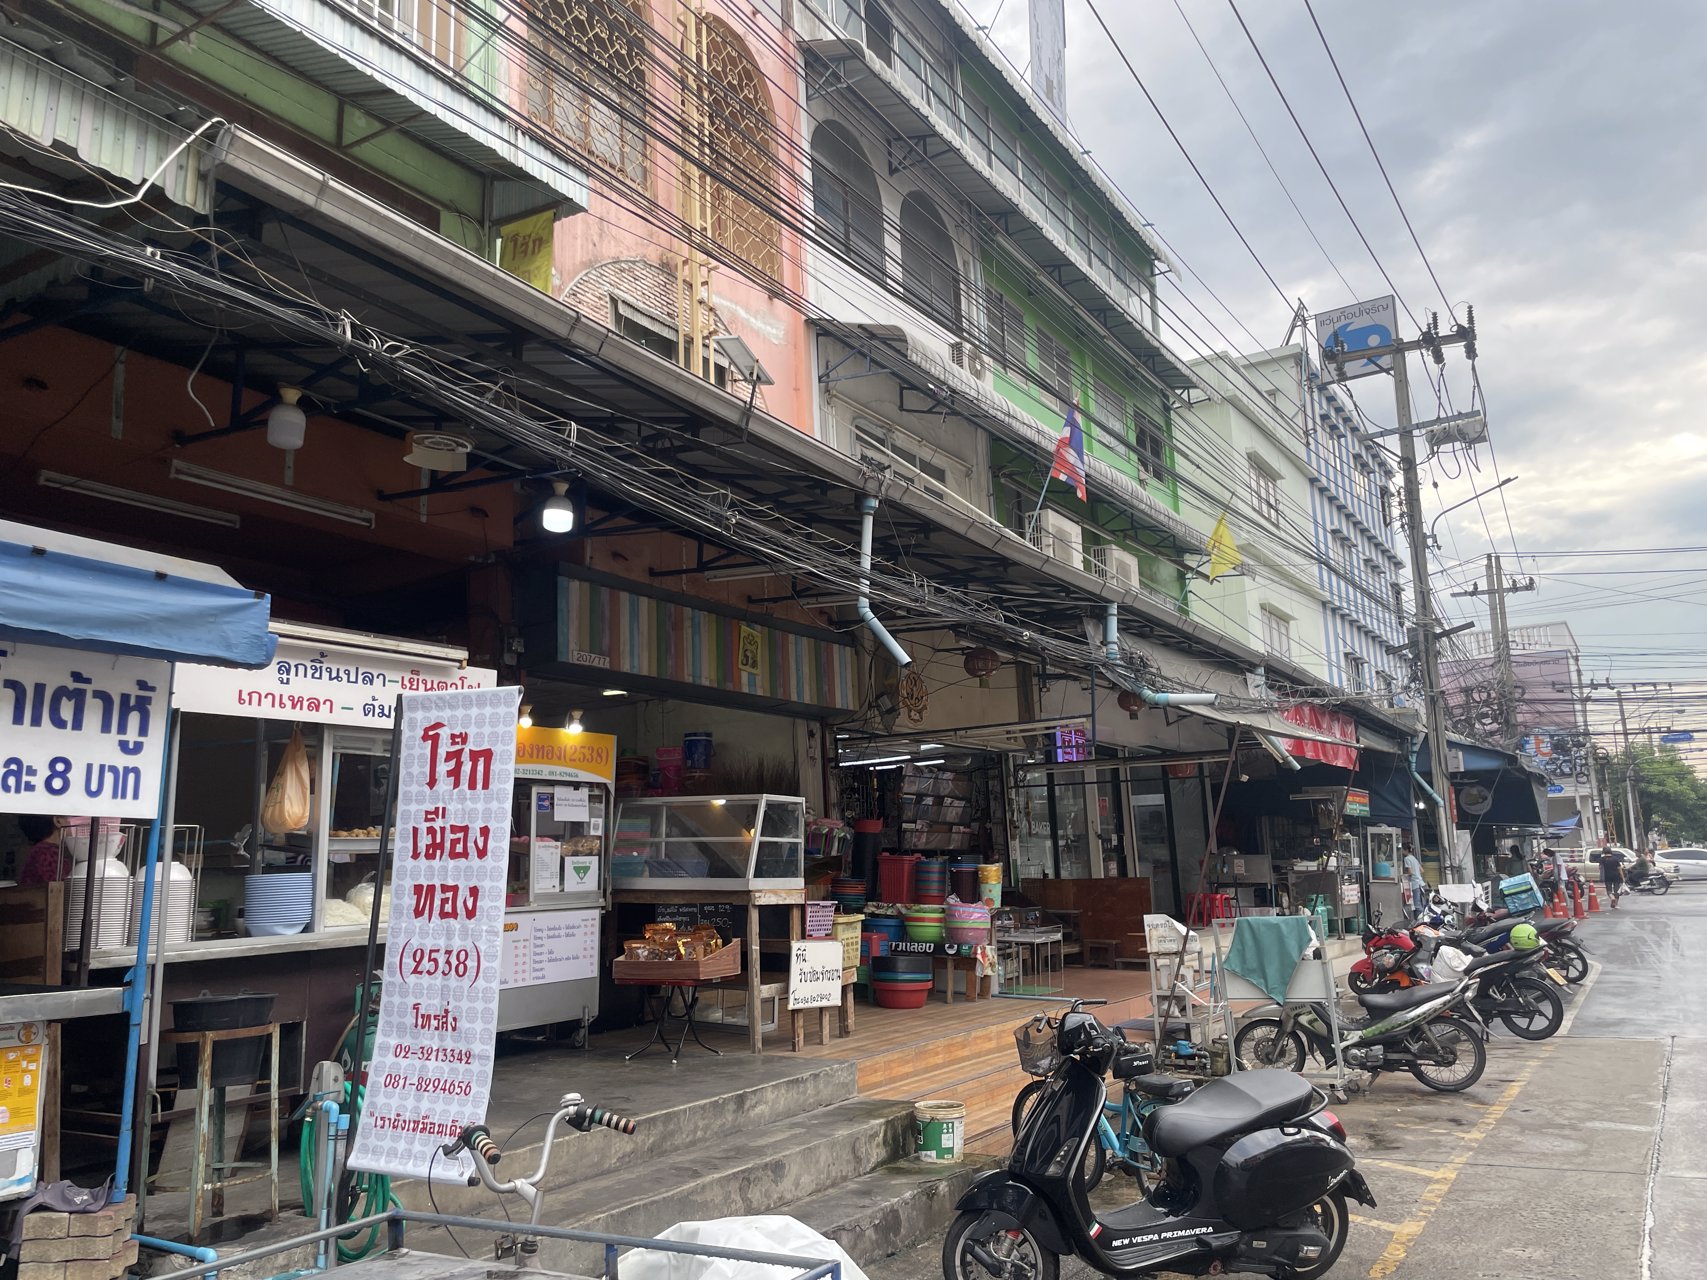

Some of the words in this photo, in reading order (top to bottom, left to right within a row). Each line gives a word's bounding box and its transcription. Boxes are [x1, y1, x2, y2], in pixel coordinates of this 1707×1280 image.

[1320, 302, 1389, 327] แว่นท็อปเจริญ
[576, 652, 607, 667] 207/77
[237, 688, 334, 713] เกาเหลา
[362, 695, 397, 719] ต้ม
[421, 721, 494, 790] โจ๊ก
[517, 742, 610, 767] องทอง(2538)
[44, 756, 73, 796] 8
[84, 762, 142, 801] บาท
[410, 806, 491, 862] เมือง
[1031, 820, 1051, 834] BAKER
[412, 883, 480, 924] ทอง
[398, 938, 481, 988] (2538)
[412, 1001, 459, 1032] โทรสั่ง
[393, 1043, 473, 1065] 02-3213342
[383, 1073, 473, 1097] 081-8294656
[1112, 1237, 1130, 1247] NEW
[1132, 1233, 1159, 1243] VESPA
[1161, 1226, 1214, 1239] PRIMAVERA
